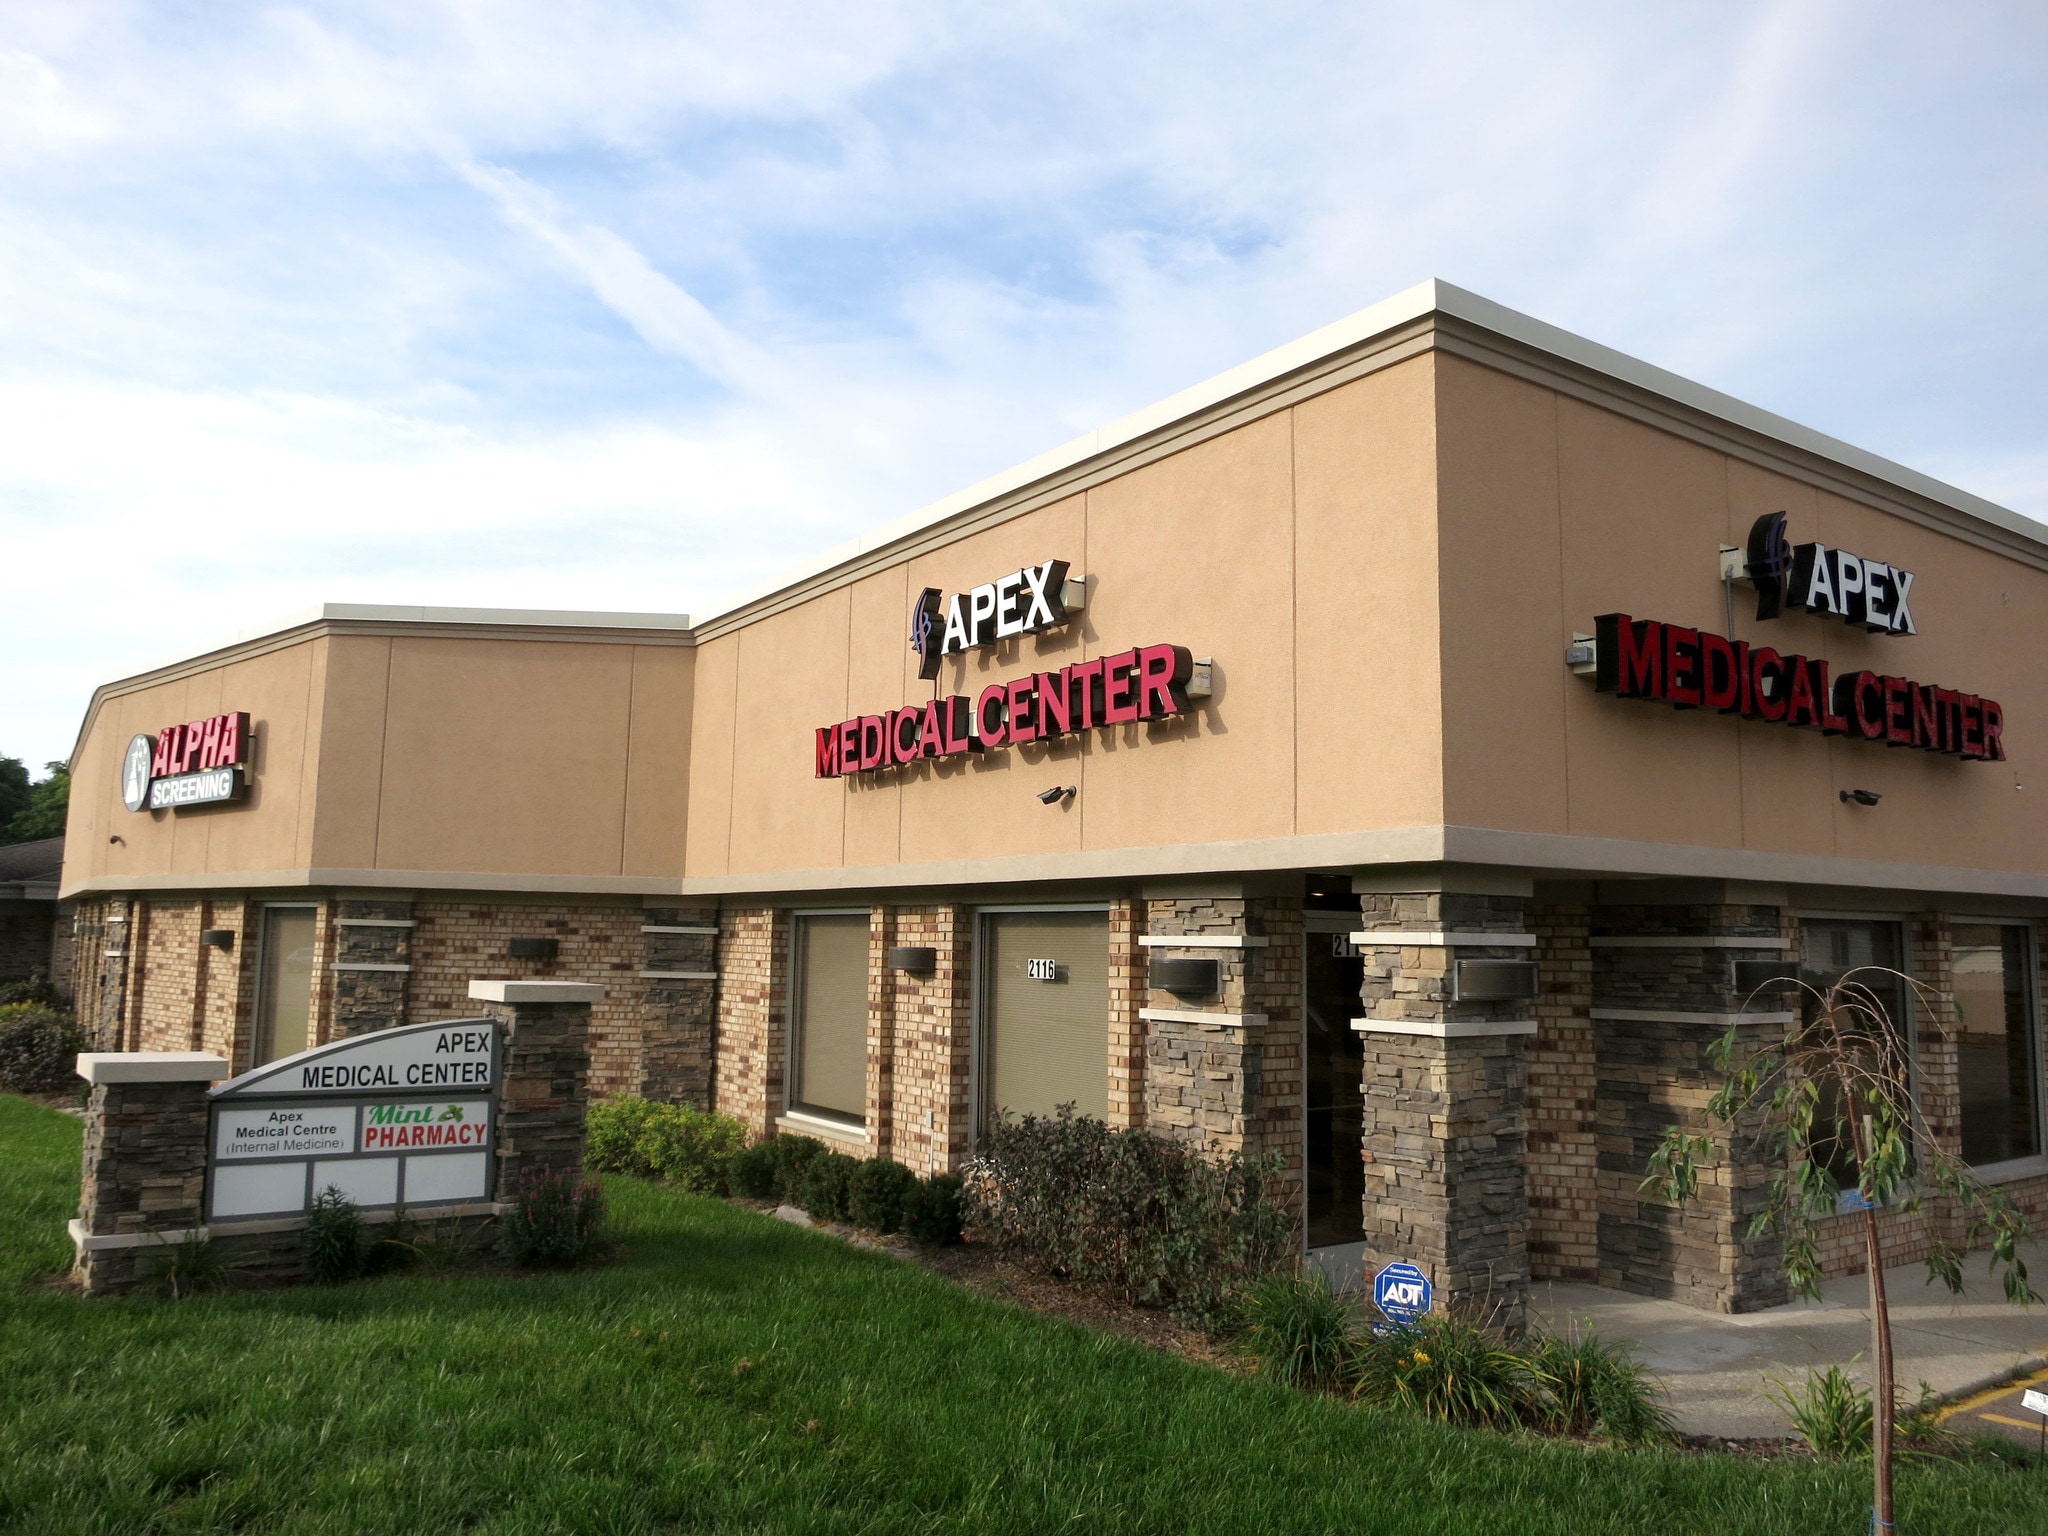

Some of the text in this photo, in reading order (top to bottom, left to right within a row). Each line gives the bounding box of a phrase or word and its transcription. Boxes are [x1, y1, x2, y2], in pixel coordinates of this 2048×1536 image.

[1807, 543, 1917, 634] APEX
[941, 559, 1055, 656] APEX
[1617, 613, 2006, 762] MEDICAL CENTER
[815, 643, 1177, 778] MEDICAL CENTER
[150, 711, 241, 778] ALPHA
[153, 772, 230, 806] SCREENING
[1334, 935, 1359, 956] 211
[1029, 959, 1054, 979] 2116
[435, 1032, 490, 1054] APEX
[302, 1062, 488, 1088] MEDICAL CENTER
[268, 1112, 303, 1124] Apex
[368, 1103, 434, 1125] Mint
[236, 1125, 337, 1138] Medical Centre
[365, 1123, 487, 1148] PHARMACY
[226, 1138, 344, 1155] (Internal Medicine)
[1383, 1281, 1422, 1306] ADT
